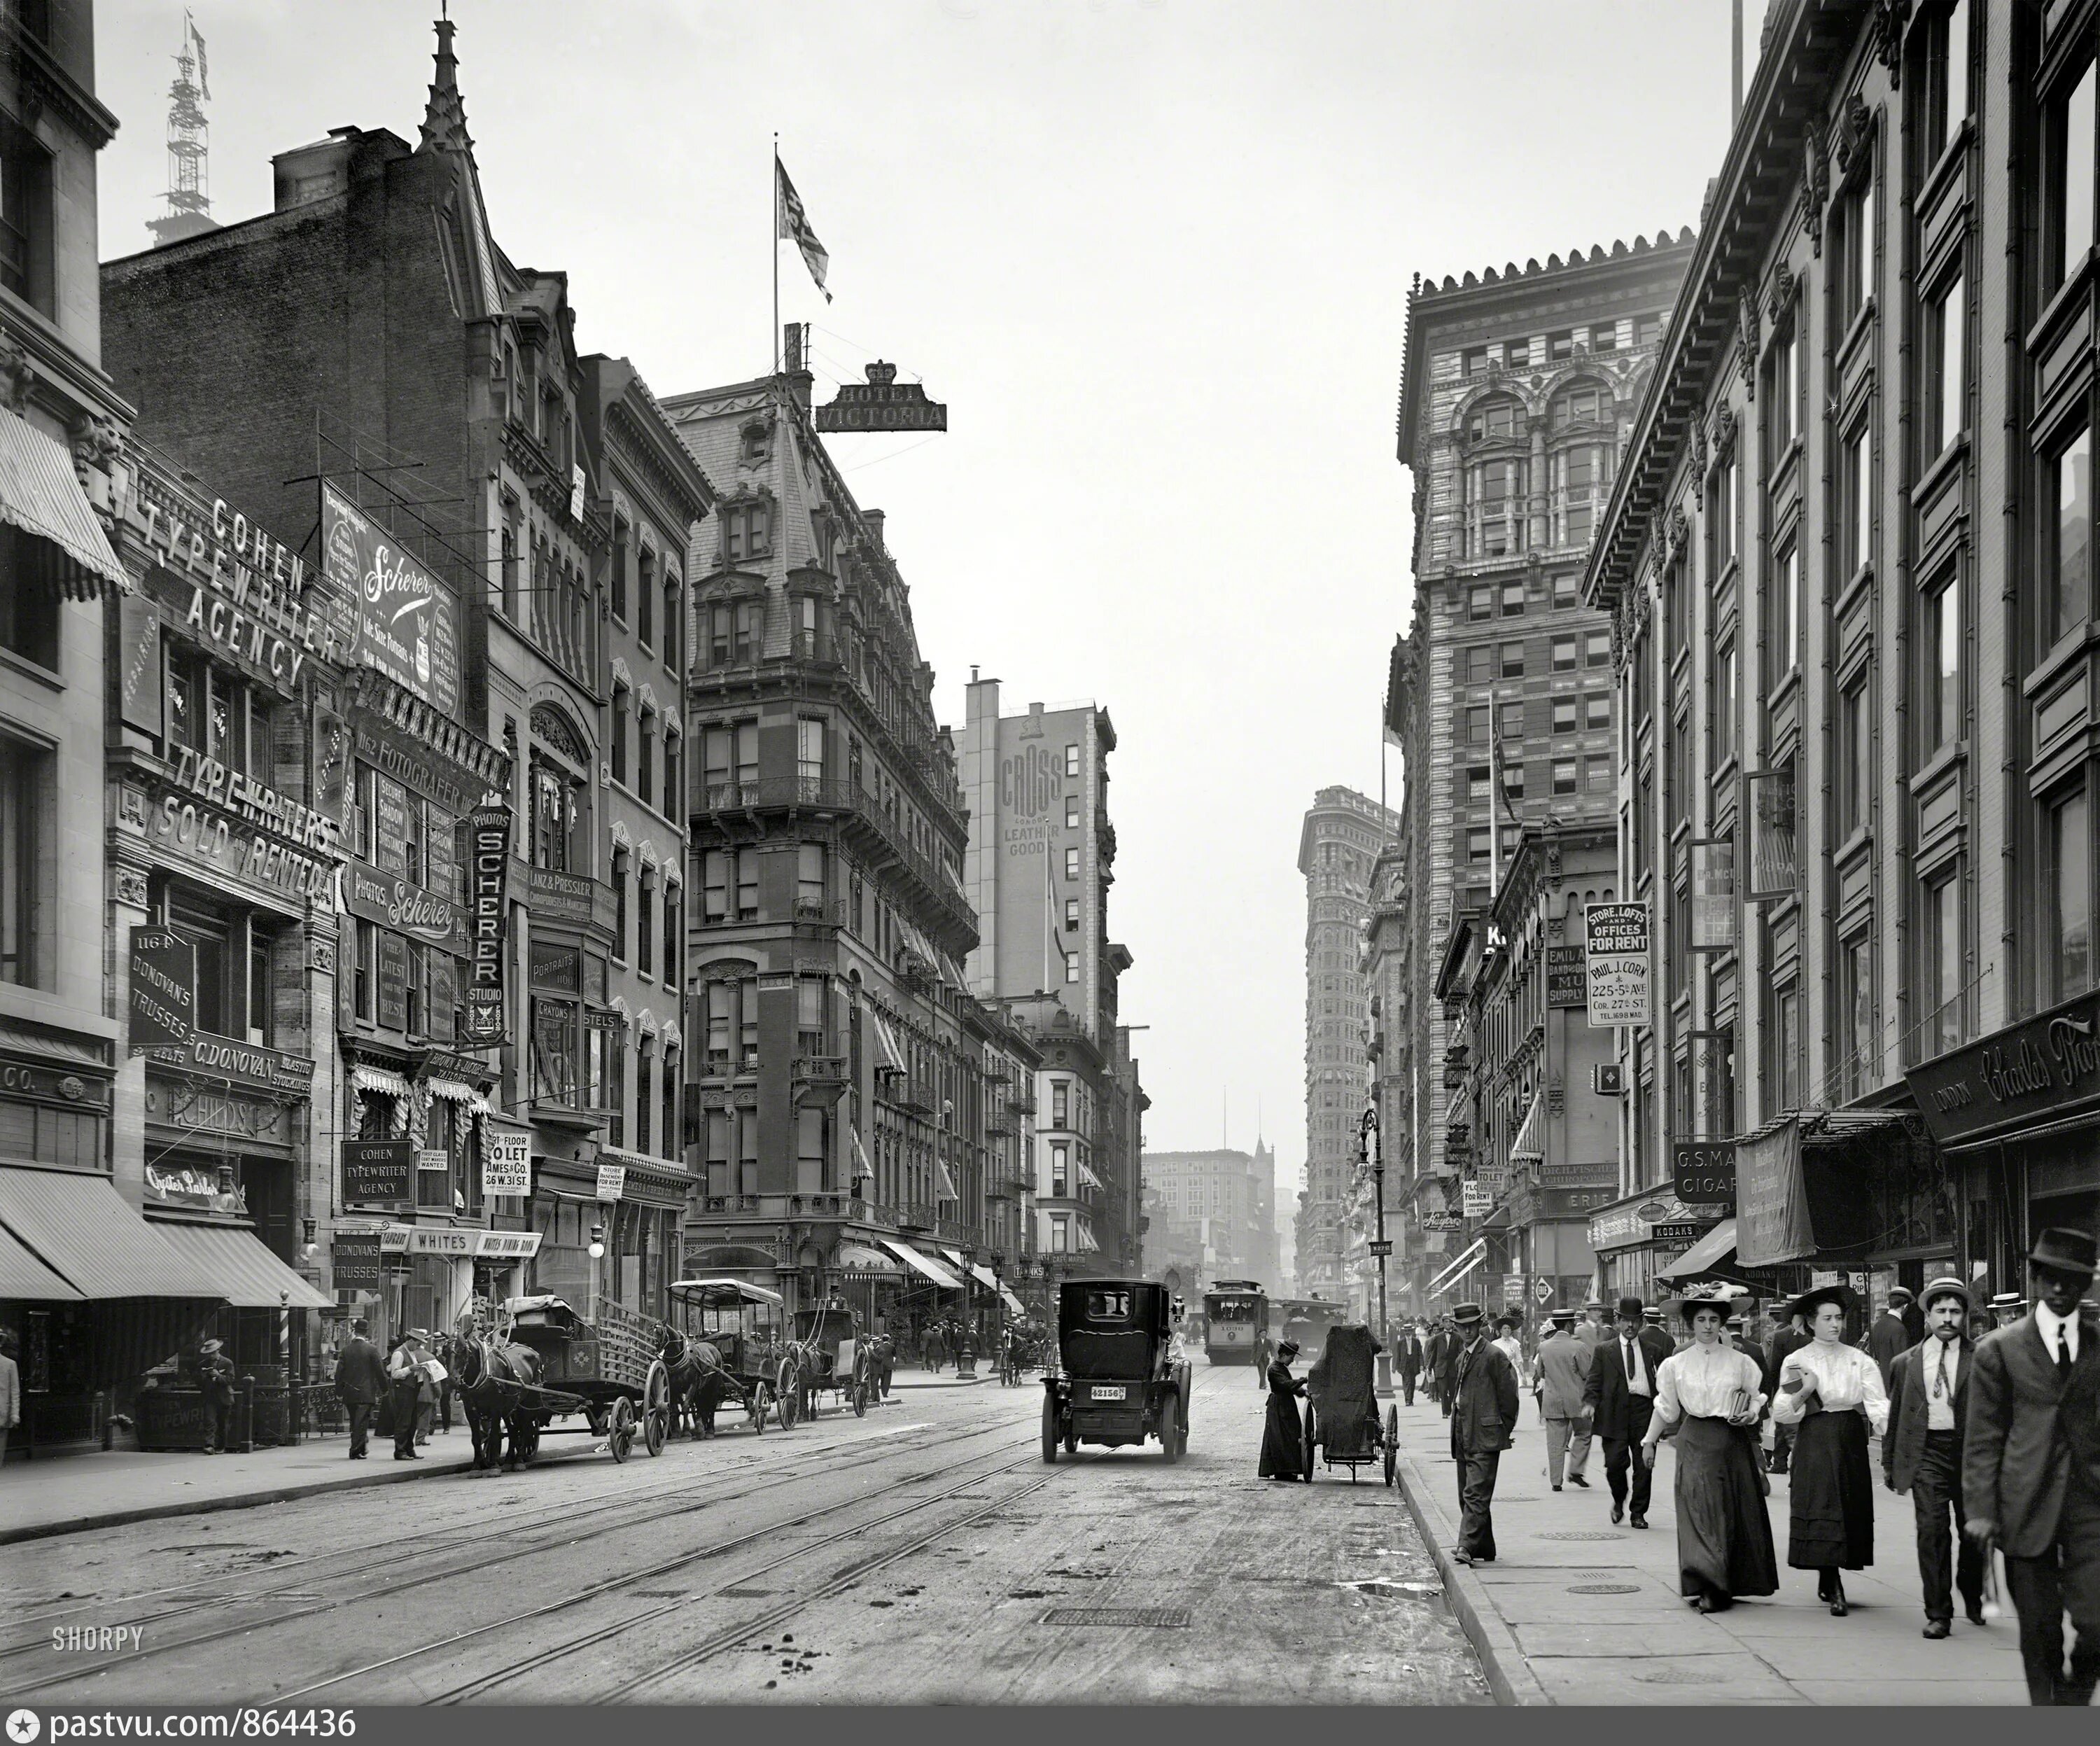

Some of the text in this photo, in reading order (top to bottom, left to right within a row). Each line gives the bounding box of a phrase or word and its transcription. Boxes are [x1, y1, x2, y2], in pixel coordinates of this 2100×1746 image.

[842, 386, 919, 403] HOTEL
[817, 407, 944, 426] VICTORIA
[212, 498, 304, 594] COHEN
[145, 501, 337, 664] TYPEWRITER
[364, 545, 433, 603] Scherer
[187, 588, 304, 687] AGENCY
[363, 613, 374, 638] Life
[374, 623, 386, 647] Size
[387, 631, 408, 663] Portraits
[124, 615, 157, 706] REPAIRING
[316, 729, 340, 799] SUPPLIES
[358, 731, 377, 756] 1162
[378, 740, 460, 805] FOTOGRAFER
[1002, 744, 1062, 818] CROSS
[380, 779, 402, 802] SECURE
[341, 775, 354, 840] PHOTOS
[379, 799, 404, 824] SHADOW
[472, 813, 510, 827] PHOTOS
[158, 796, 229, 858] SOLD
[247, 836, 322, 897] RENTED
[530, 869, 592, 897] LANZ & PRESSLER.
[354, 872, 453, 926] PHOTOS. Scherer
[475, 832, 504, 982] SCHERER
[530, 891, 562, 908] CHIROPODISTS
[1588, 906, 1646, 926] STORE, LOFTS
[1594, 924, 1641, 936] OFFICES
[137, 935, 172, 949] 1164
[1589, 935, 1647, 951] FOR RENT
[1549, 950, 1574, 963] EMIL
[380, 959, 405, 978] LATEST
[533, 954, 573, 981] PORTRAITS
[1549, 965, 1567, 976] BAND
[1590, 961, 1647, 980] PAUL J. CORN
[132, 956, 192, 1007] DONOVAN'S
[469, 988, 503, 1001] STUDIO
[1550, 989, 1585, 1002] SUPPLY
[1632, 998, 1647, 1008] ST.
[131, 988, 188, 1040] TRUSSES
[382, 998, 406, 1018] BEST.
[538, 1003, 568, 1019] CRAYONS
[280, 1053, 312, 1074] ELASTIC
[430, 1054, 453, 1070] BROWN
[454, 1058, 461, 1070] &
[1980, 1039, 2052, 1102] Charles
[4, 1066, 36, 1089] CO.
[271, 1073, 311, 1092] STOCKINGS
[437, 1069, 468, 1084] TAILORS
[504, 1136, 526, 1145] FLOOR
[360, 1149, 393, 1160] COHEN
[505, 1147, 527, 1161] LET
[346, 1165, 407, 1178] TYPEWRITER
[486, 1164, 510, 1174] AMES
[1479, 1173, 1504, 1181] TO LET
[146, 1166, 185, 1199] Oyster
[358, 1182, 397, 1195] AGENCY
[486, 1175, 528, 1185] 26 ST.
[1570, 1194, 1609, 1208] ERIE
[1656, 1226, 1693, 1237] KODAKS
[335, 1244, 379, 1257] DONOVAN'S
[419, 1234, 466, 1250] WHITE'S
[335, 1266, 378, 1279] TRUSSES
[1015, 1267, 1043, 1277] TNKS
[1091, 1389, 1119, 1397] 42156
